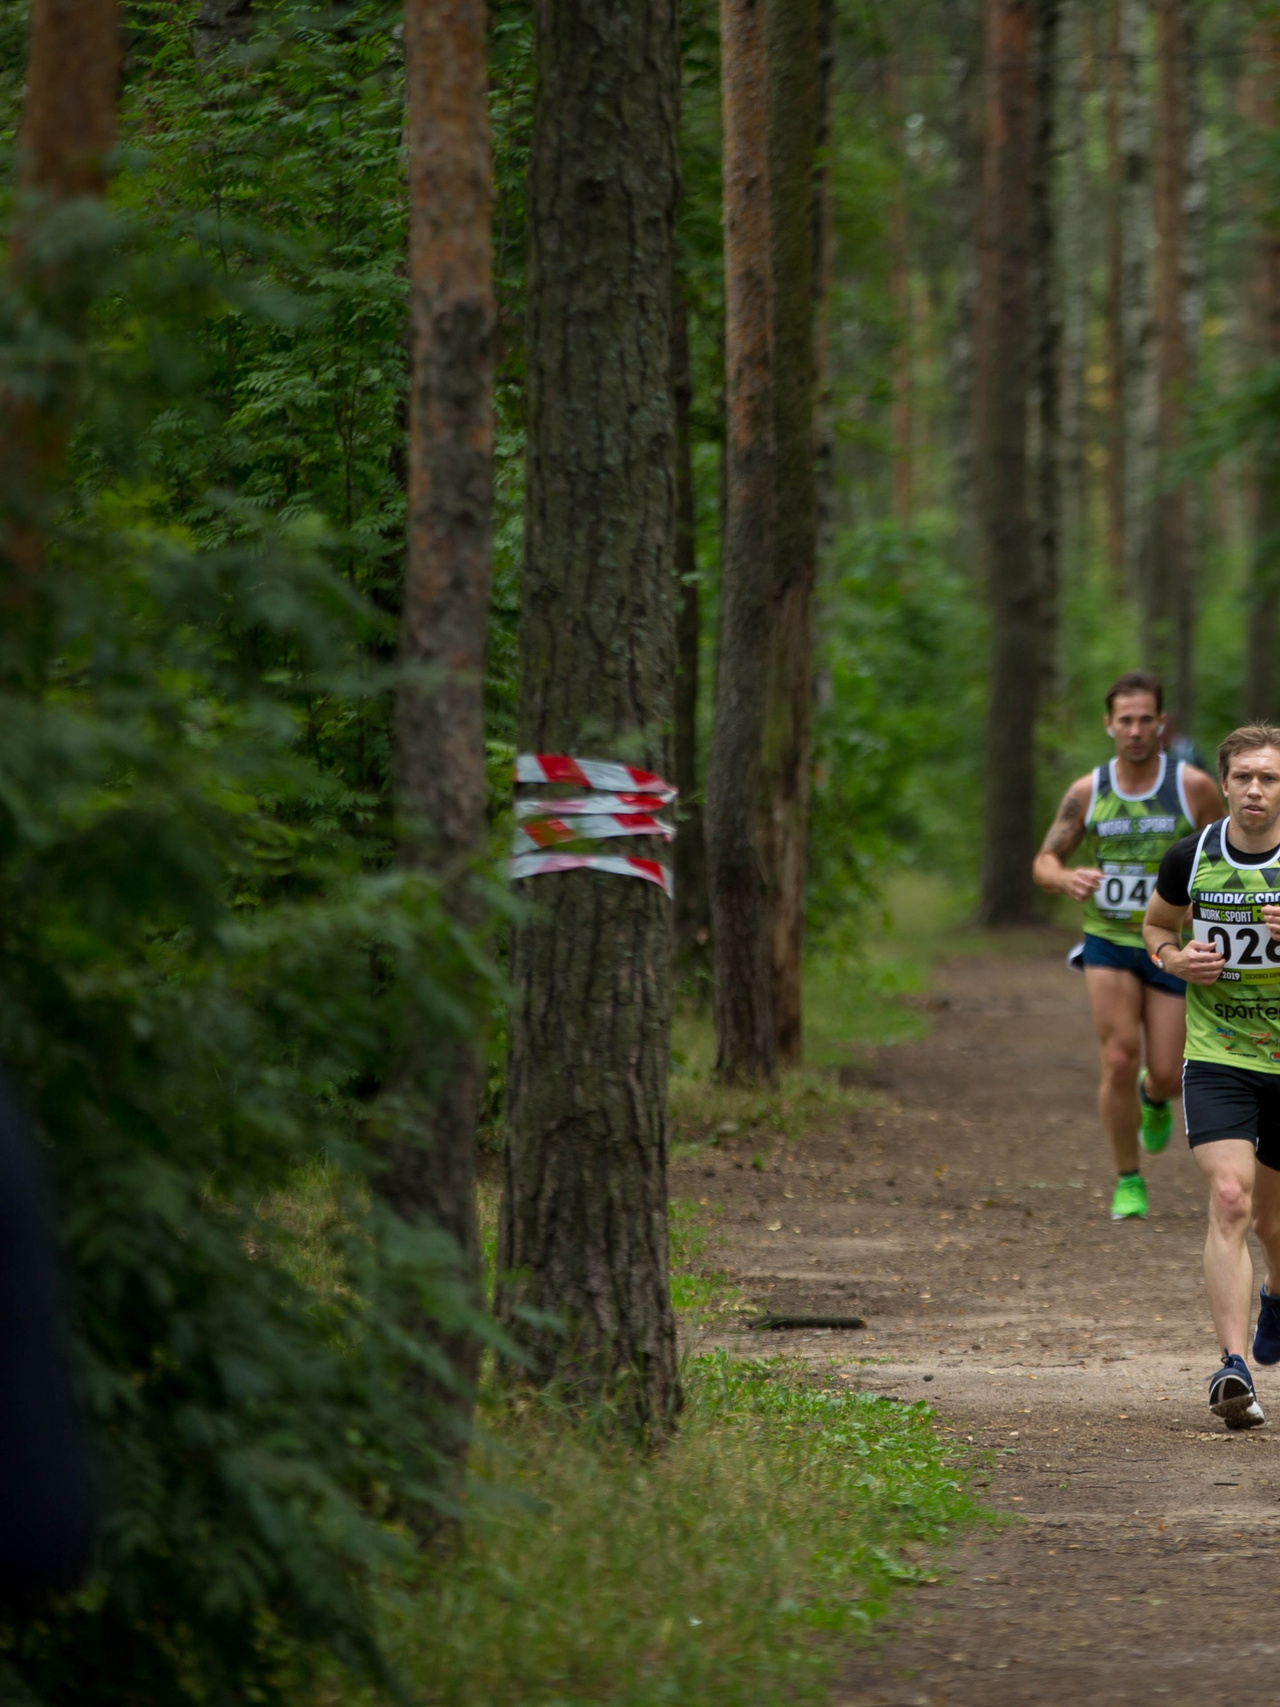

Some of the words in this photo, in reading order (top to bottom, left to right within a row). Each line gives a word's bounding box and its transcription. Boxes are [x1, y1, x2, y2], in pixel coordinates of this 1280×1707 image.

[1106, 877, 1157, 907] 04
[1200, 907, 1252, 922] WORK&SPORT
[1217, 971, 1241, 981] .2019
